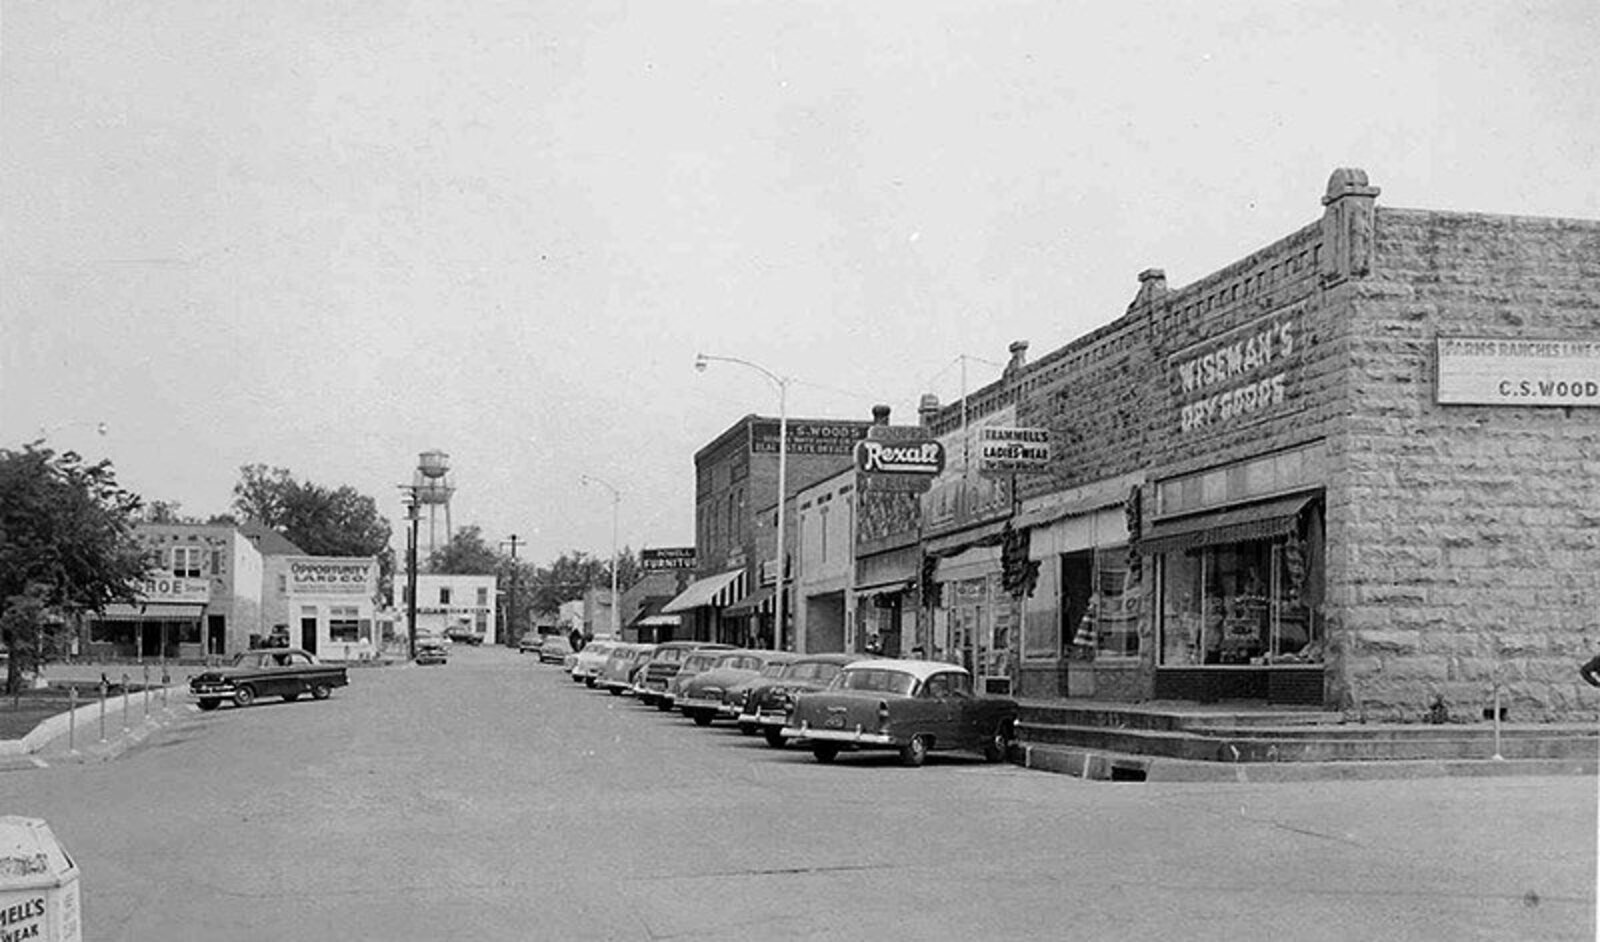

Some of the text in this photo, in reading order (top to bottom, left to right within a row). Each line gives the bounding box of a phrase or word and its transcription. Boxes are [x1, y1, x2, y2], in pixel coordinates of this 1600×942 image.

[1179, 319, 1293, 393] WISEMAN'S
[1445, 341, 1496, 356] FARMS
[1498, 342, 1561, 357] RANCHES
[1180, 373, 1286, 432] DRY GOODS
[864, 442, 939, 471] Rexall
[291, 562, 371, 575] OPPORTUNITY
